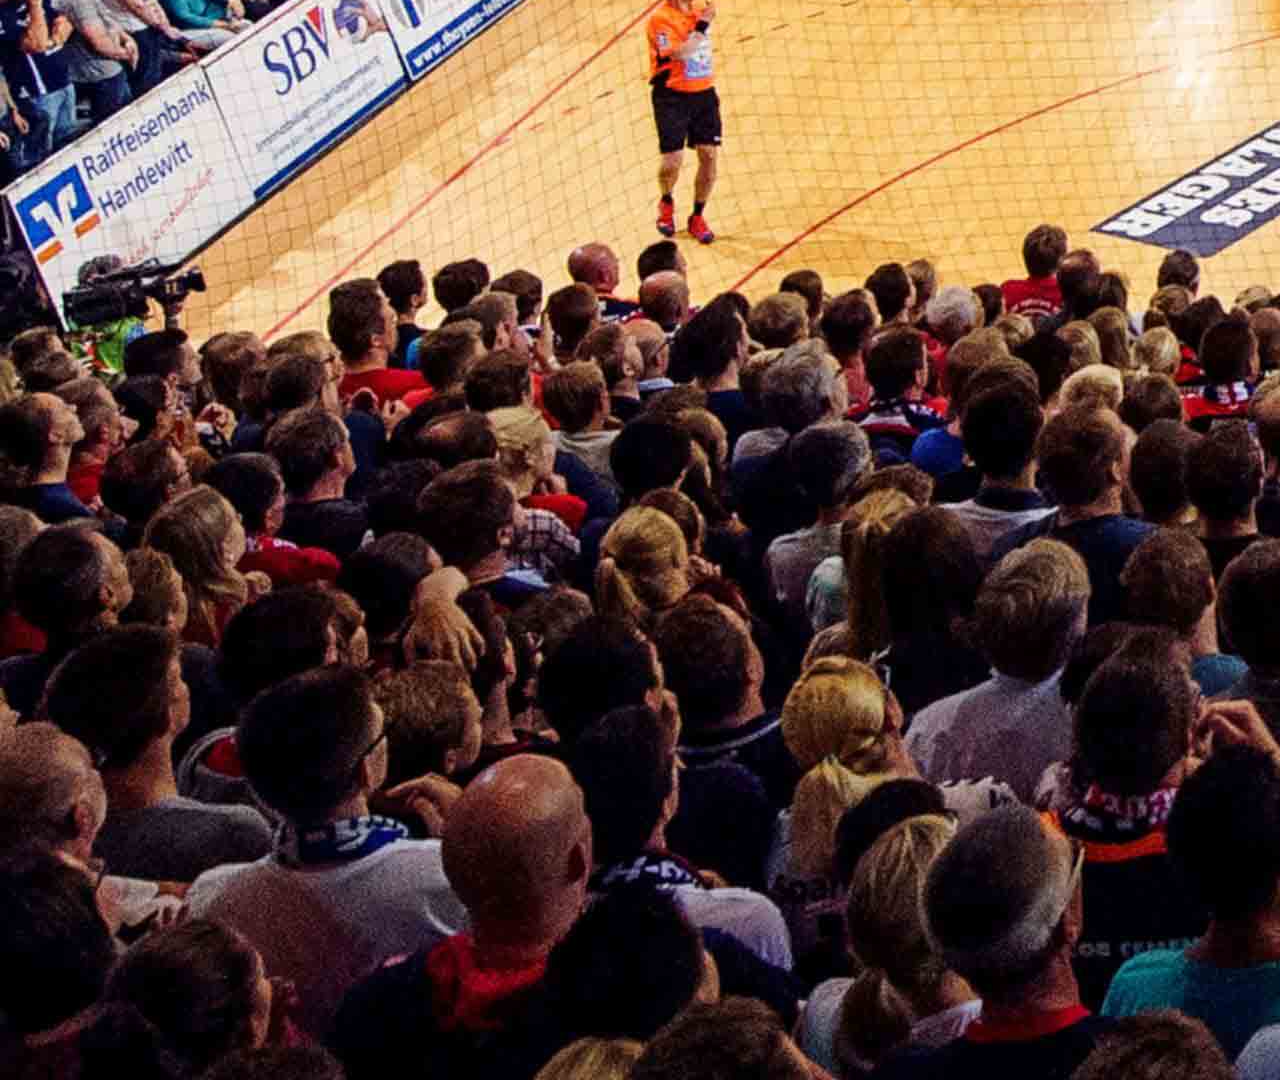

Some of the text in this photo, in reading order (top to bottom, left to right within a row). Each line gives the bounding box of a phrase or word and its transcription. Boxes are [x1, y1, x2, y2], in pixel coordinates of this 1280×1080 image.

[262, 5, 332, 96] SBV
[81, 79, 211, 181] Raiffeisenbank
[98, 138, 194, 219] Handewitt
